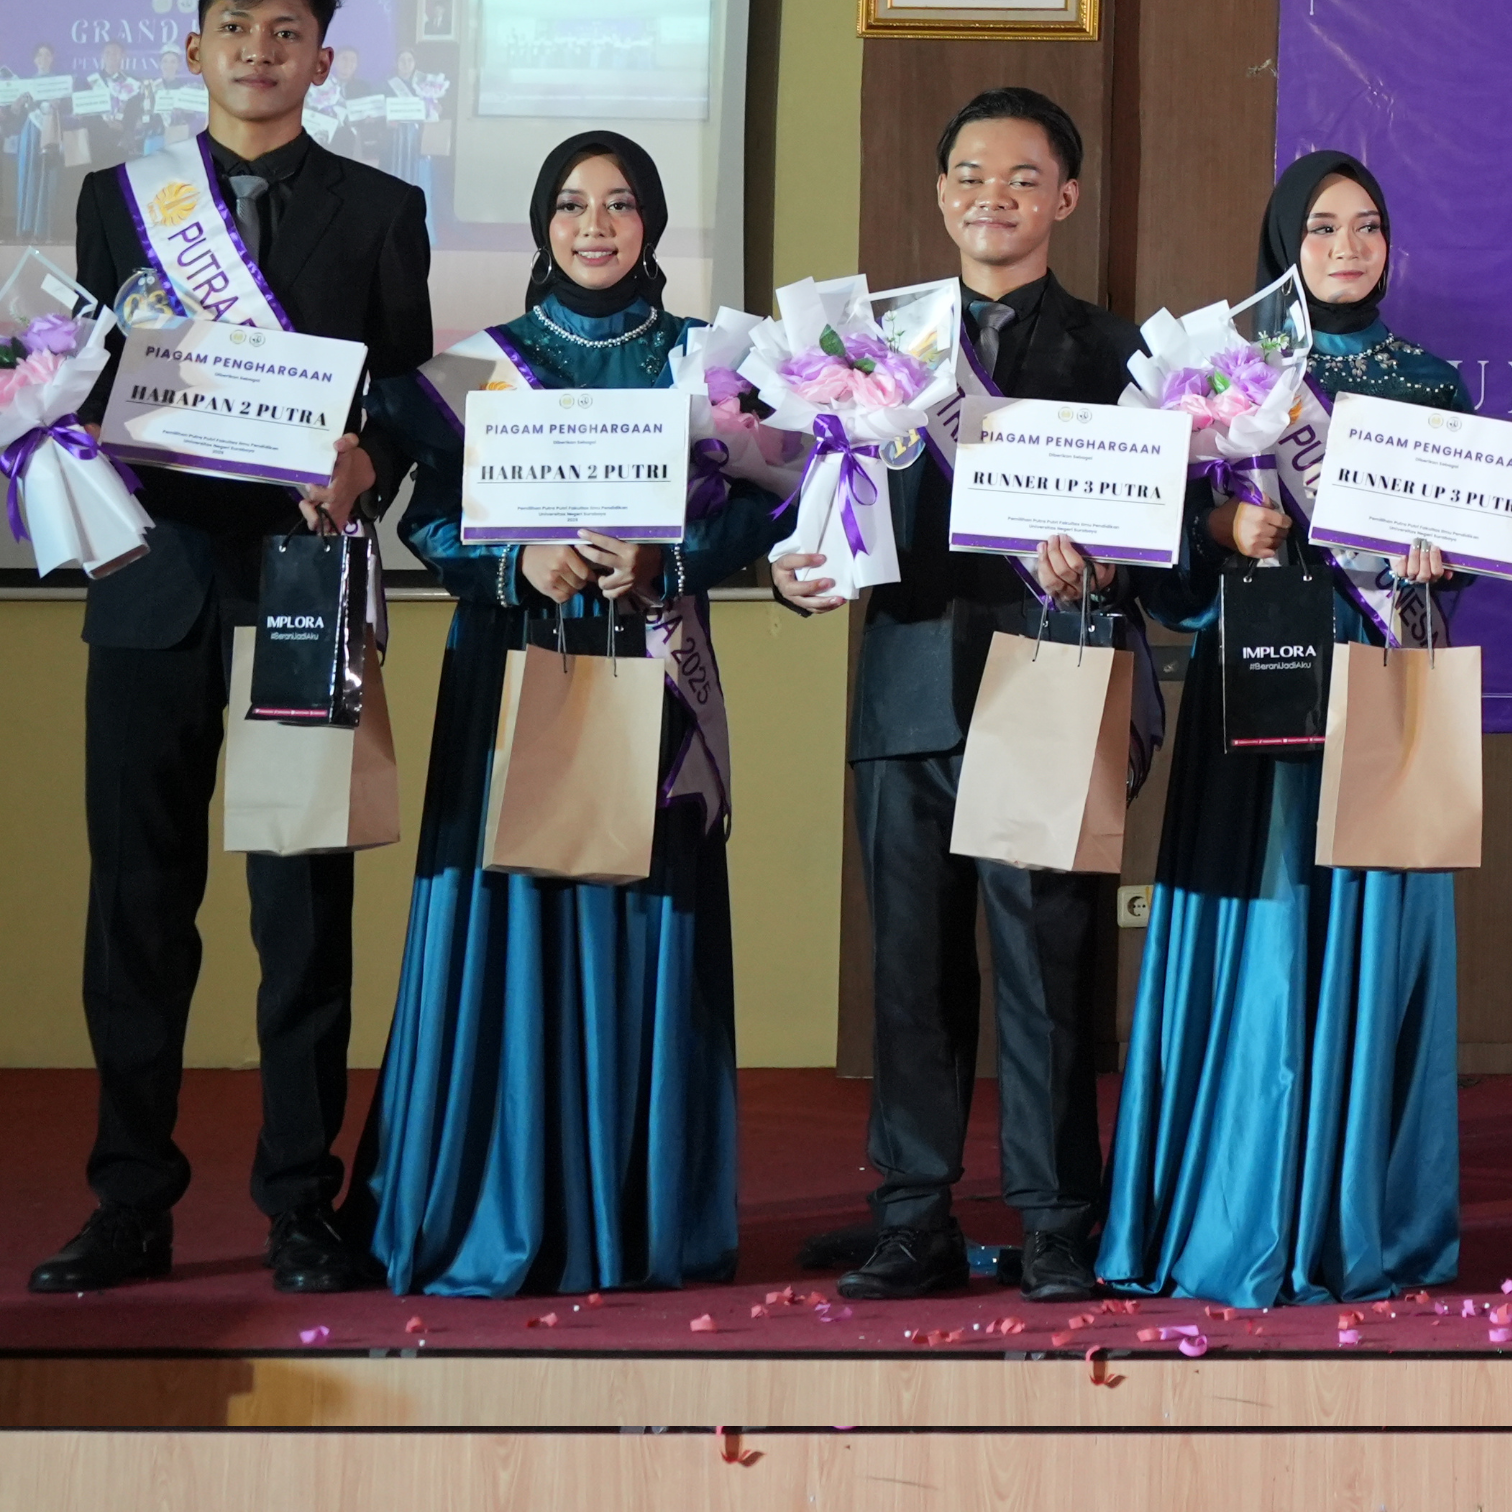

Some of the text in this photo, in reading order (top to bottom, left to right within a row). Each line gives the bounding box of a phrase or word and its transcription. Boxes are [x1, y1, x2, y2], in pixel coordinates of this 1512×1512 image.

[71, 18, 178, 43] GRAND
[167, 221, 239, 322] PUTRA
[145, 346, 333, 383] PIAGAM PENGHARGAAN
[131, 385, 327, 427] HARAPAN 2 PUTRA
[486, 424, 663, 434] PIAGAM PENGHARGAAN
[1349, 428, 1408, 449] PIAGAM
[981, 431, 1161, 455] PIAGAM PENGHARGAAN
[481, 464, 668, 480] HARAPAN 2 PUTRI
[973, 471, 1162, 499] RUNNER UP 3 PUTRA
[1338, 468, 1415, 494] RUNNER
[1422, 483, 1446, 500] UP
[1450, 489, 1460, 503] 3
[267, 615, 325, 630] IMPLORA
[1243, 645, 1317, 659] IMPLORA
[671, 637, 710, 704] 2025
